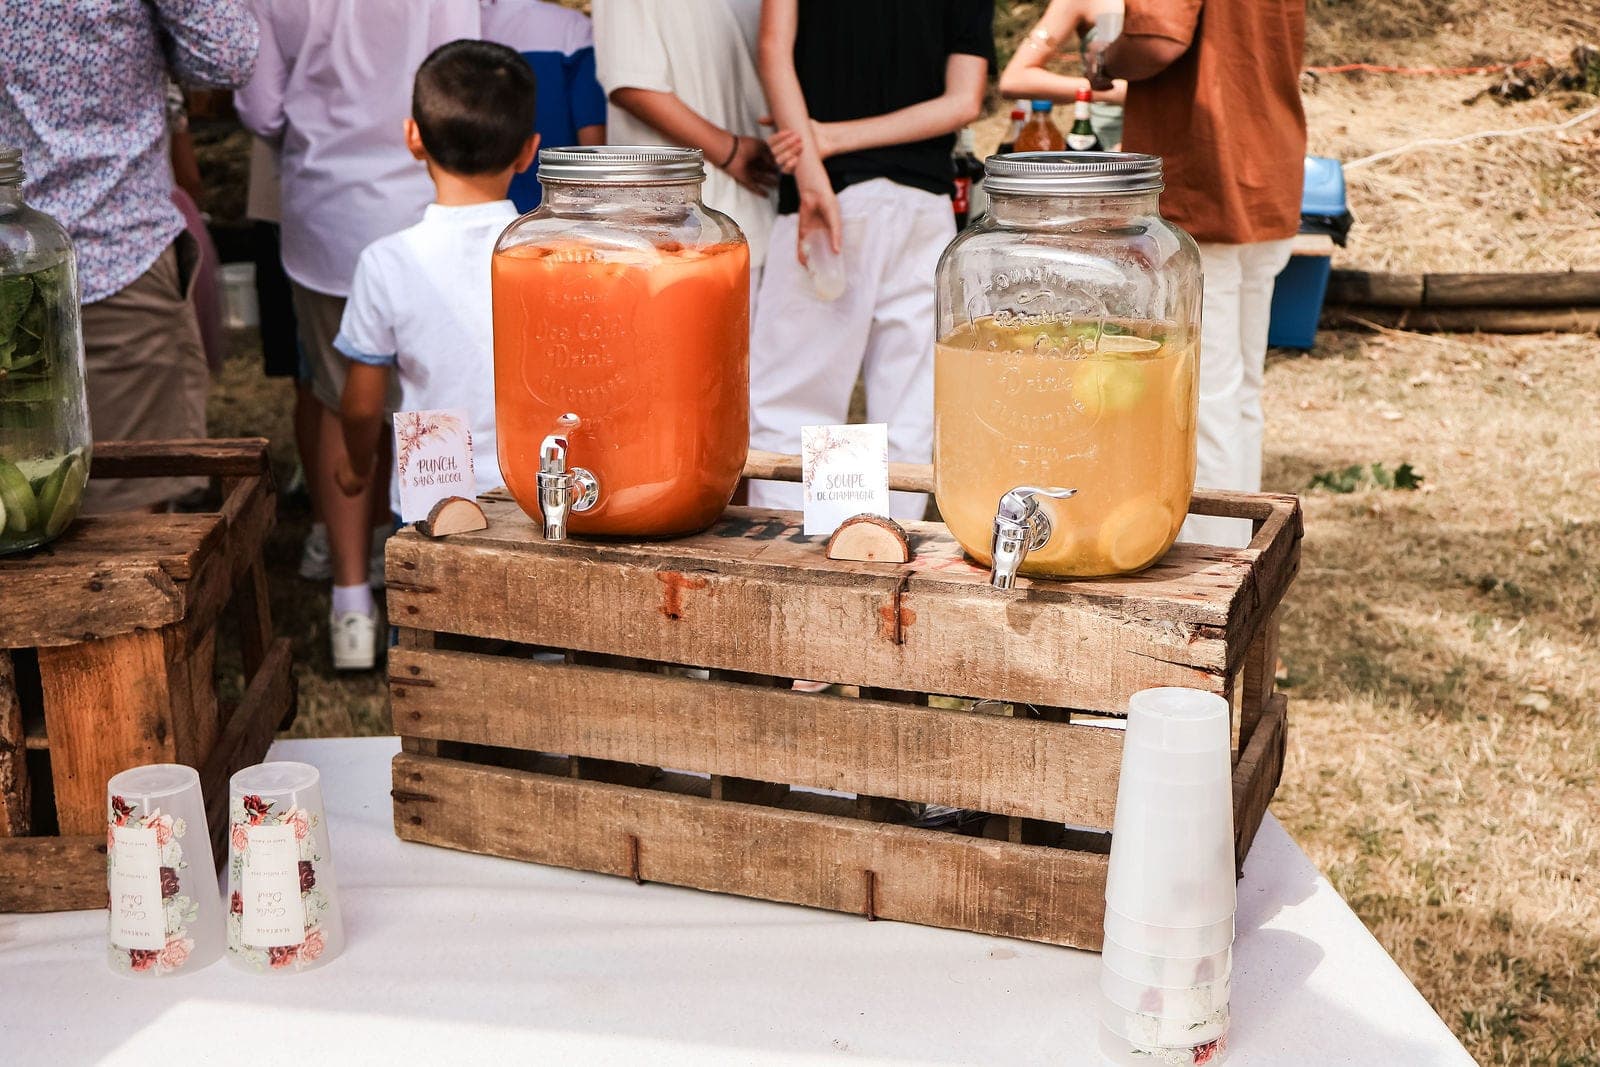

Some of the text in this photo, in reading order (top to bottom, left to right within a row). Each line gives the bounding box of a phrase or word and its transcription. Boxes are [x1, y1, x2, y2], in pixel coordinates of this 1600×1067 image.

[416, 455, 458, 474] PUNCH
[413, 472, 463, 487] SANS ALCOOL
[825, 472, 865, 490] SOUPE
[816, 489, 876, 502] DE CHAMPAGNE
